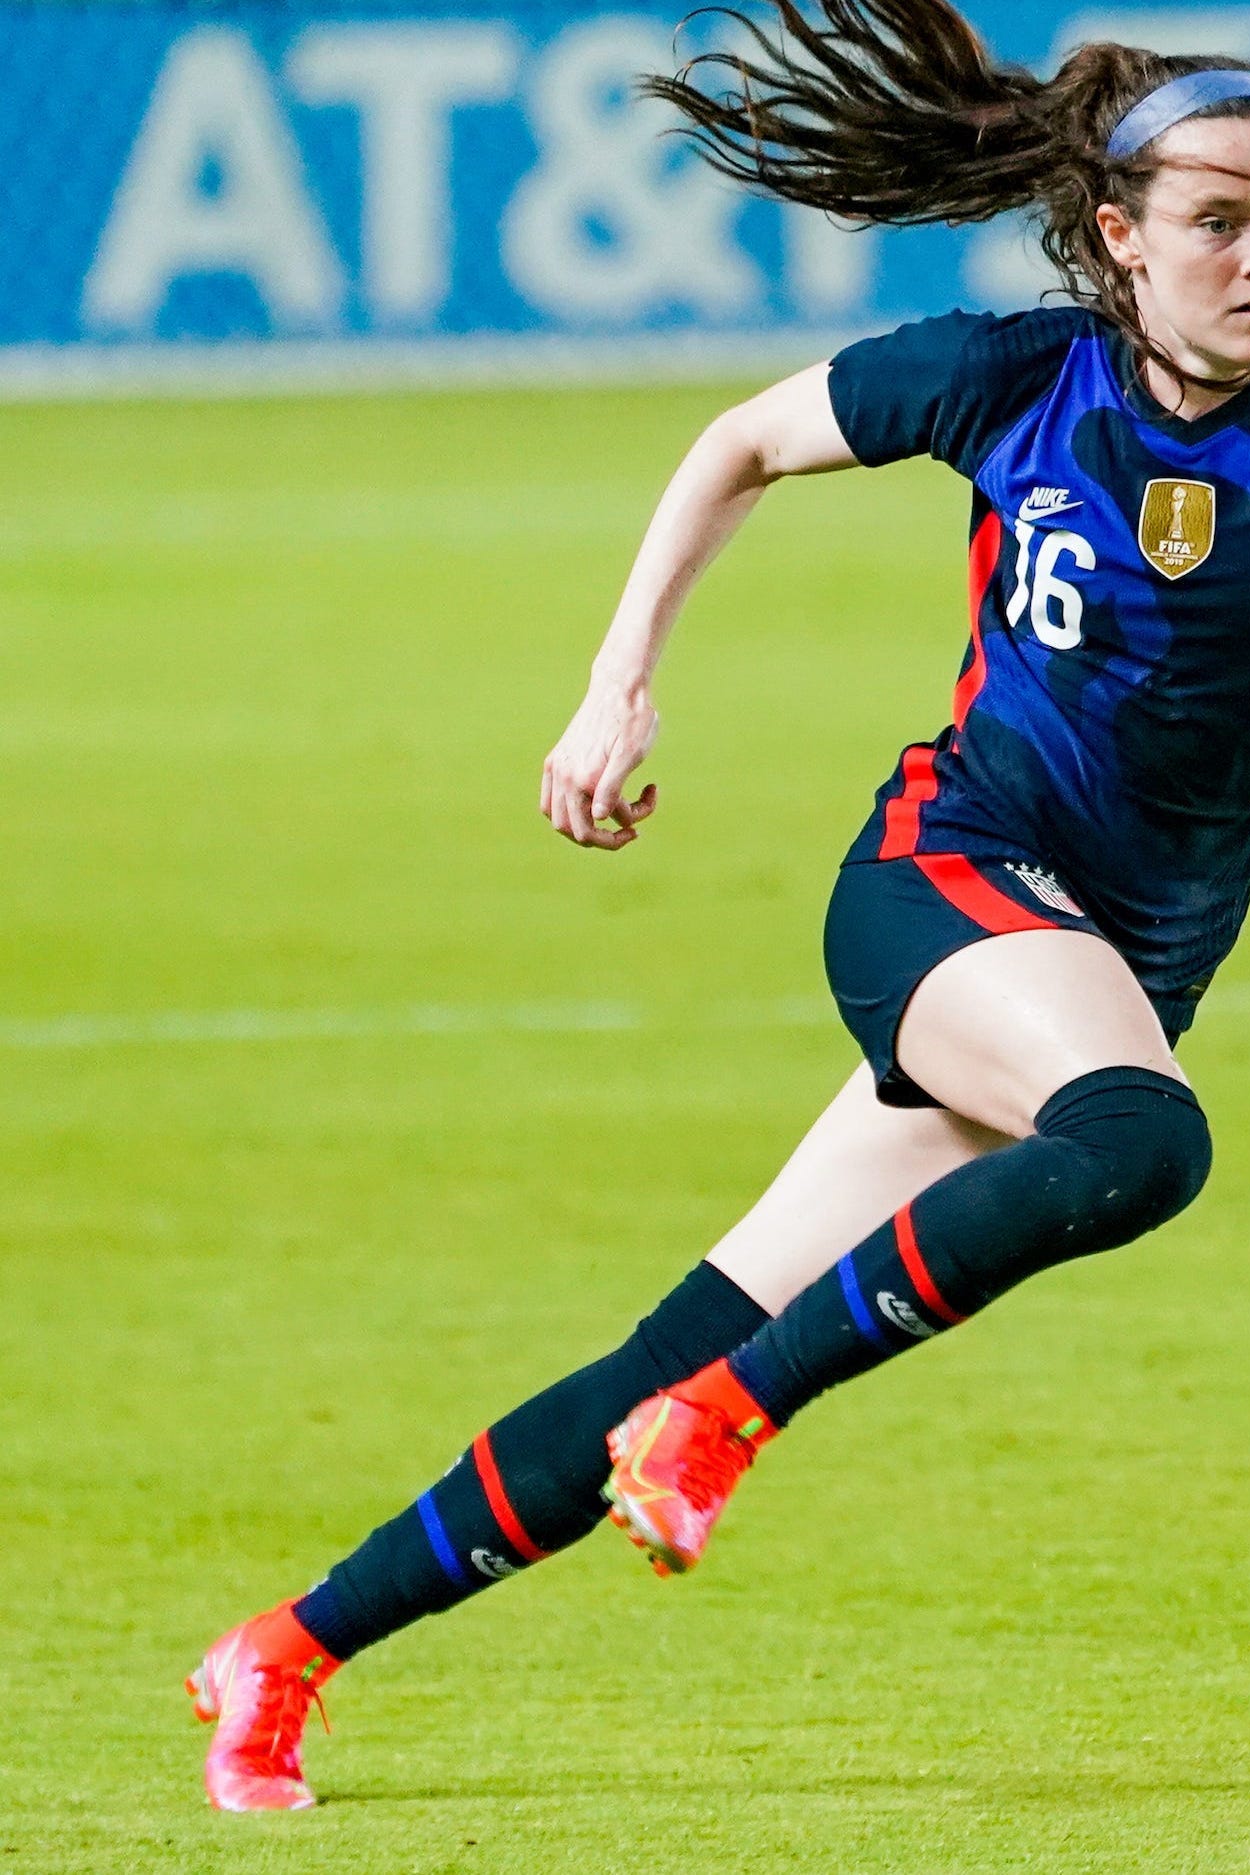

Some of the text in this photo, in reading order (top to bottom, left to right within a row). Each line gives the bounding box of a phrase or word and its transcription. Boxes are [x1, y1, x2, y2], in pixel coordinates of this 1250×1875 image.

[1027, 486, 1070, 508] NIKE
[1158, 540, 1191, 554] FIFA
[1005, 518, 1097, 651] 16
